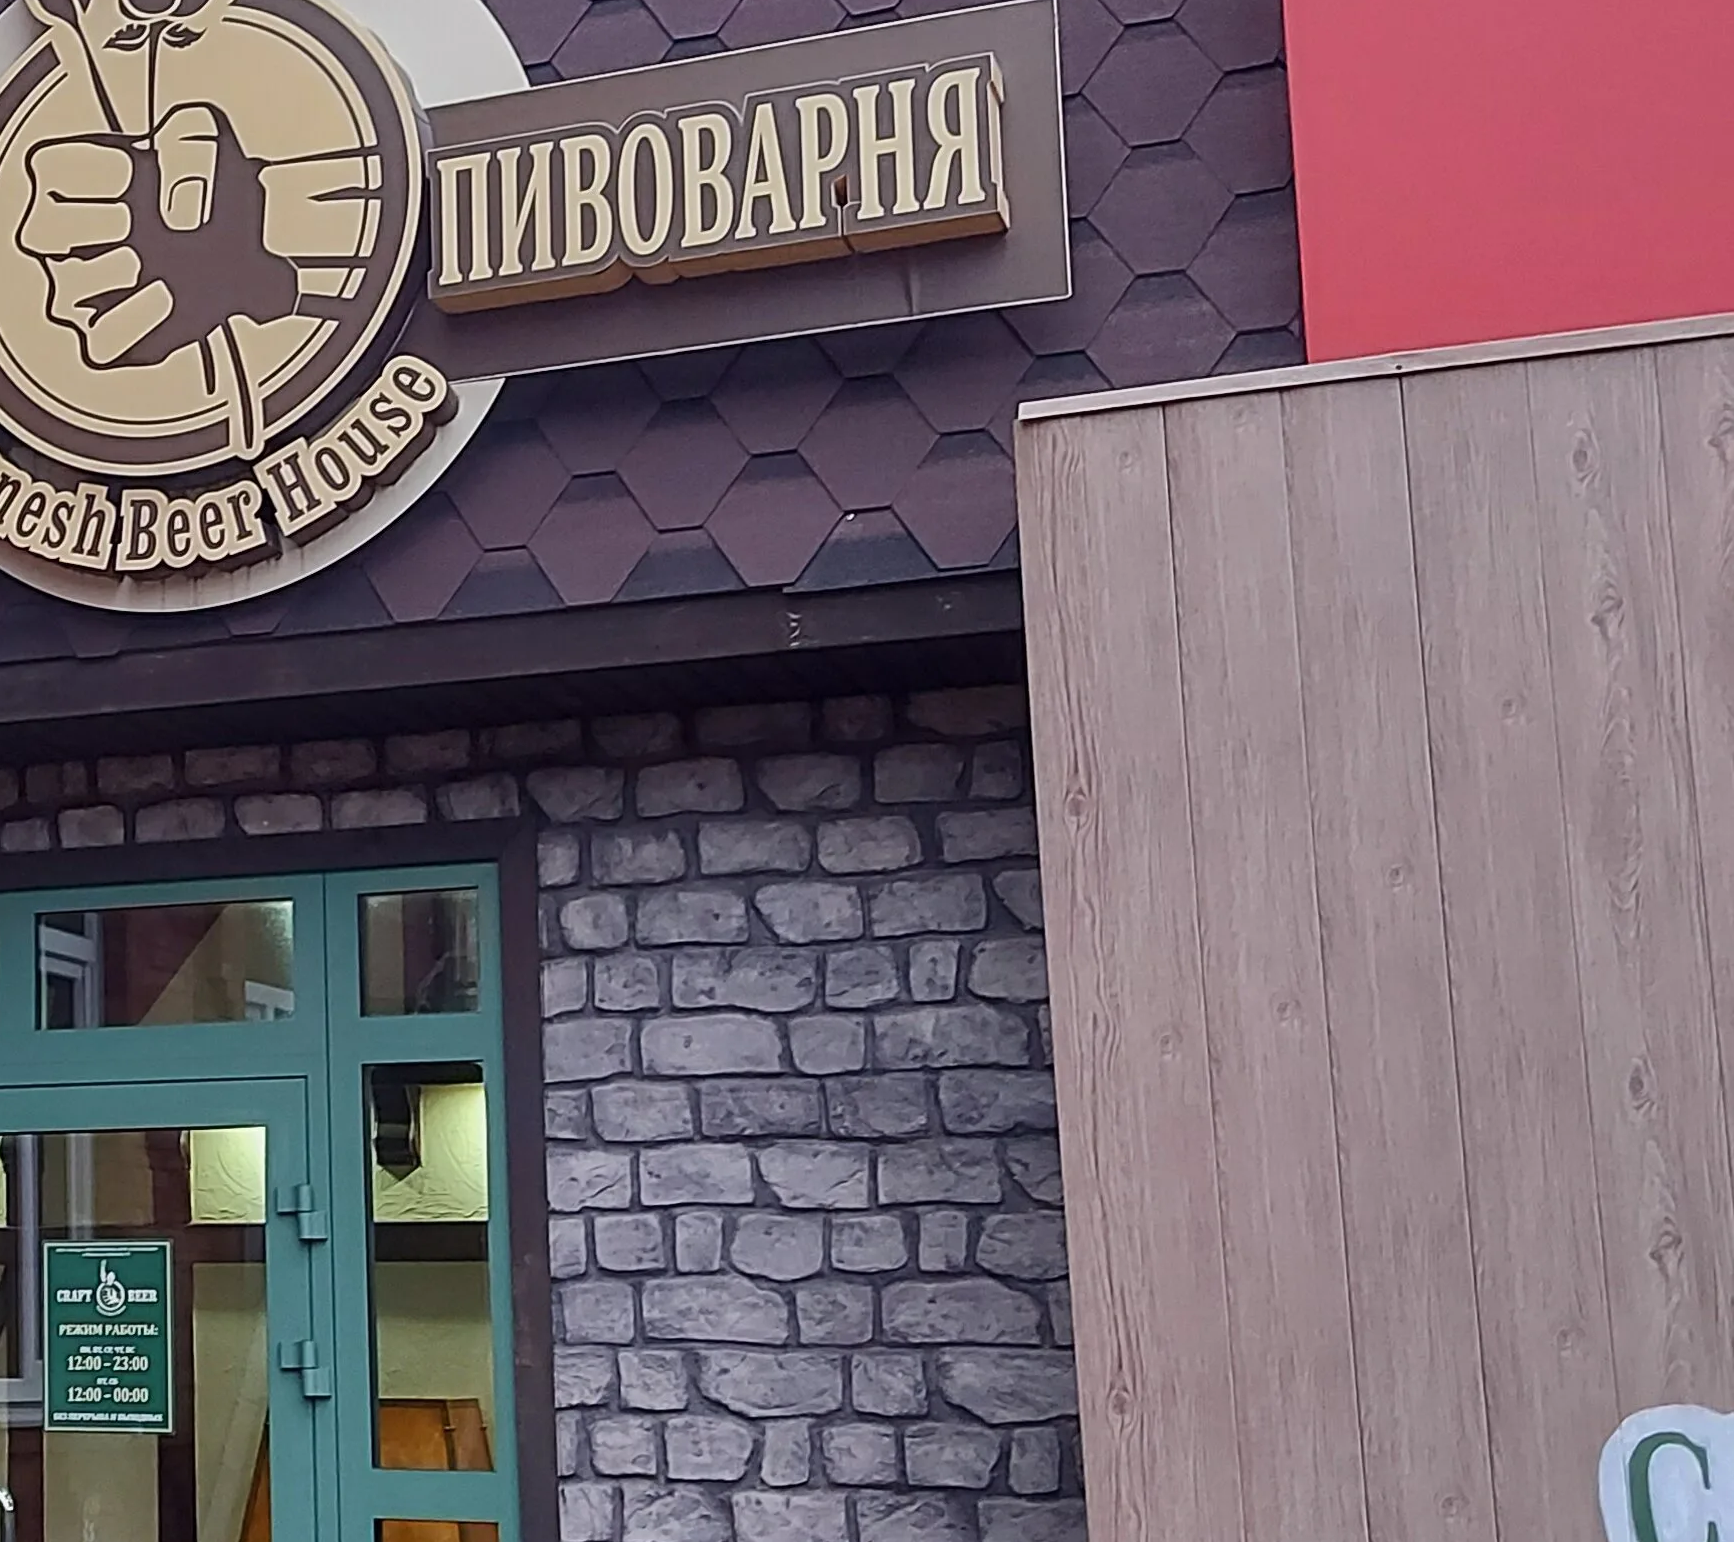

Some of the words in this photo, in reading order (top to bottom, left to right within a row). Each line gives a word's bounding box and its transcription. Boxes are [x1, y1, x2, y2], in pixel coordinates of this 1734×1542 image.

[436, 66, 987, 286] ПИВОВАРНЯ
[128, 487, 254, 562] Beer
[266, 363, 437, 524] House
[56, 1289, 94, 1303] CRAFT
[127, 1289, 158, 1302] BEER
[58, 1324, 103, 1336] РЕЖИМ
[104, 1324, 159, 1336] РАБОТЫ:
[67, 1356, 102, 1371] 12:00
[112, 1356, 149, 1371] 23:00
[67, 1387, 102, 1402] 12:00
[113, 1387, 149, 1402] 00:00
